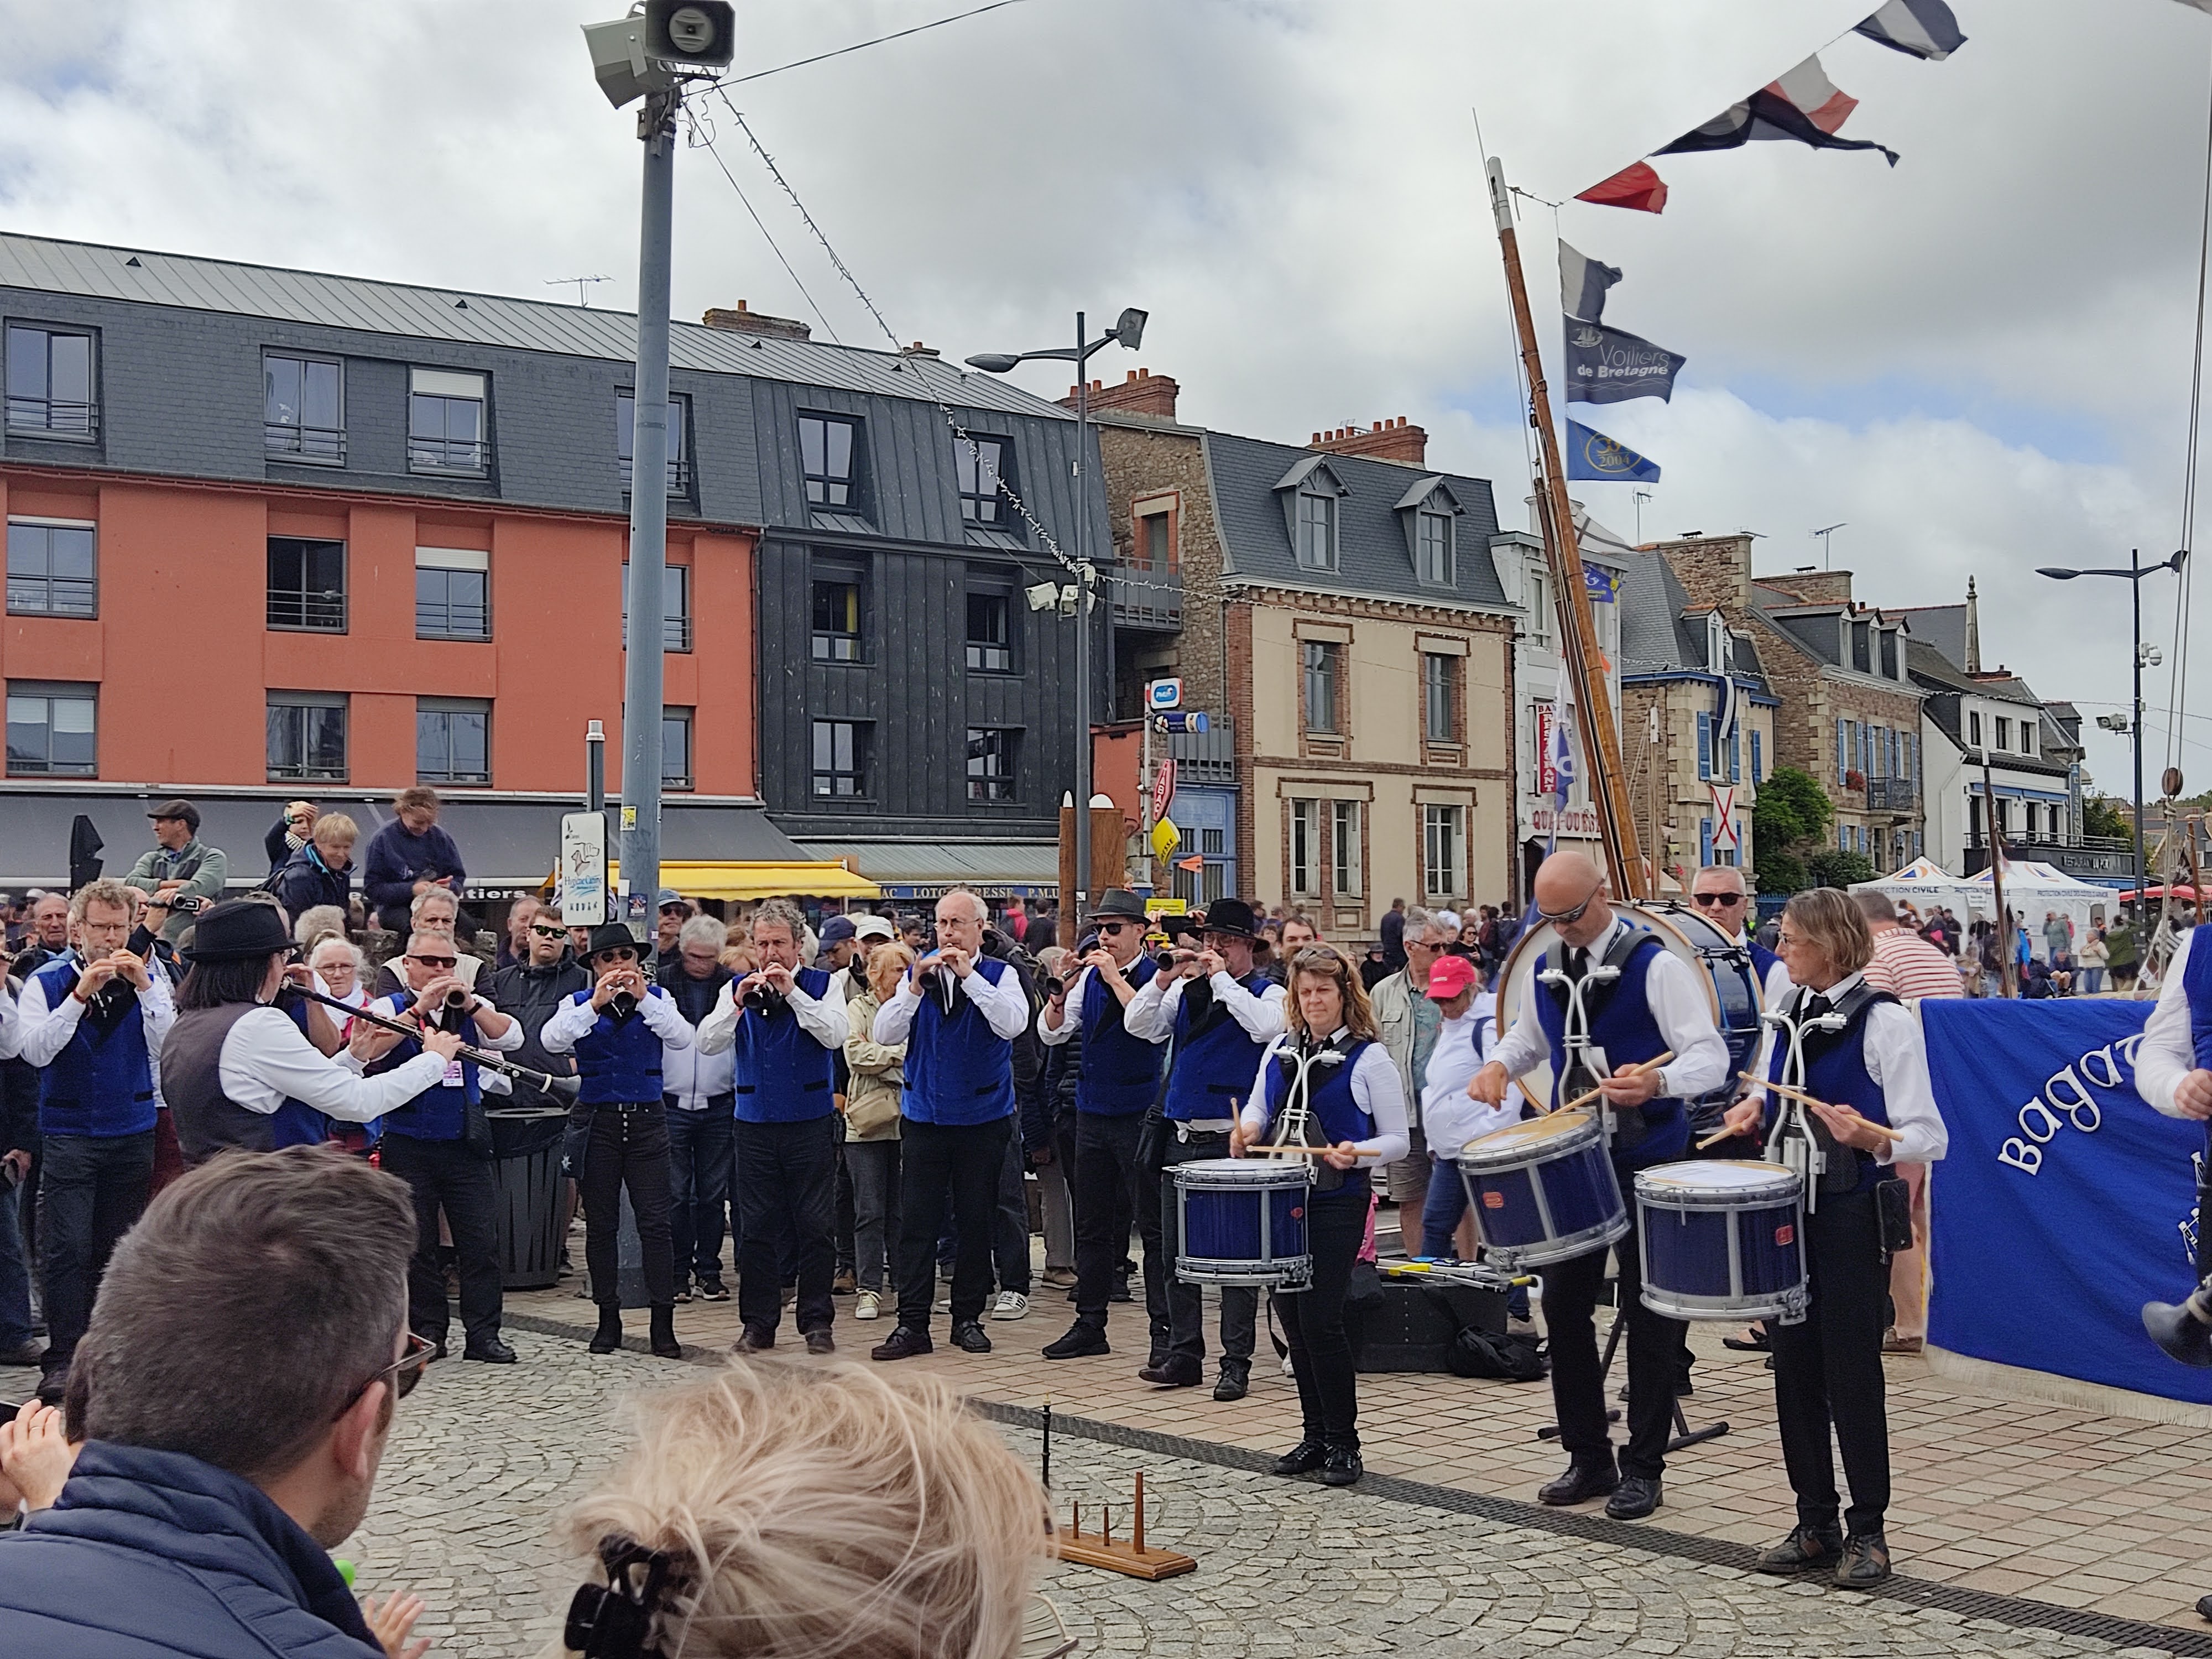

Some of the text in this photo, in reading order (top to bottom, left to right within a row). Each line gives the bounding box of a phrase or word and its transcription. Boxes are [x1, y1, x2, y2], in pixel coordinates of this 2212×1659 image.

[1600, 344, 1670, 369] Voiliers
[1577, 364, 1668, 378] de Bretagne
[1154, 768, 1168, 813] TABAC
[459, 888, 526, 899] tiers
[974, 887, 1013, 898] RESSE
[2141, 968, 2150, 979] 73
